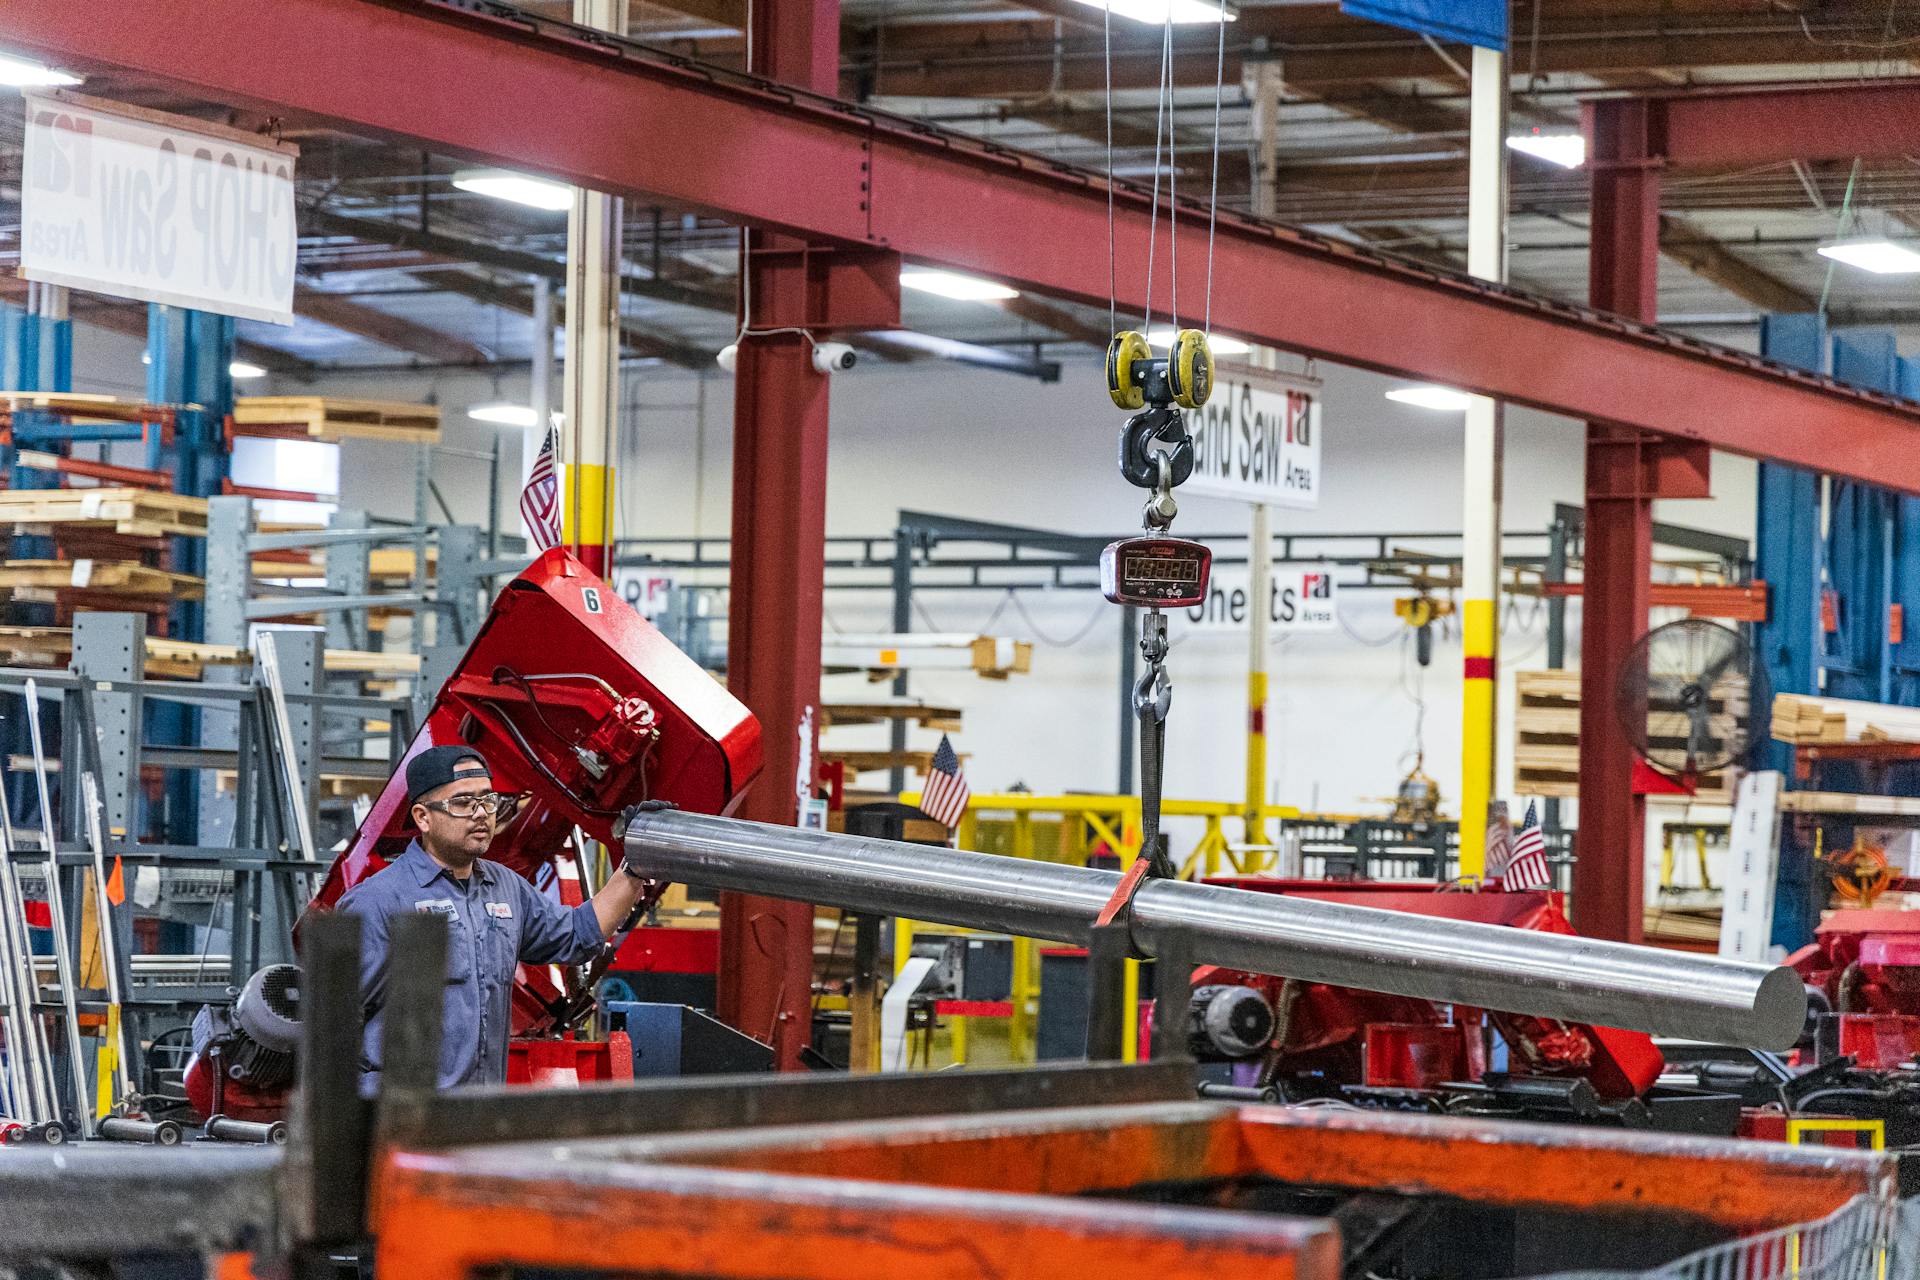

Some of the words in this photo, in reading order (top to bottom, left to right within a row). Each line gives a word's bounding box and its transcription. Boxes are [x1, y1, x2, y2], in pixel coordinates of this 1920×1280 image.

[1182, 379, 1234, 479] and
[1239, 381, 1283, 487] Saw
[1285, 459, 1312, 490] Area
[585, 589, 599, 612] 6
[1187, 576, 1296, 623] hets
